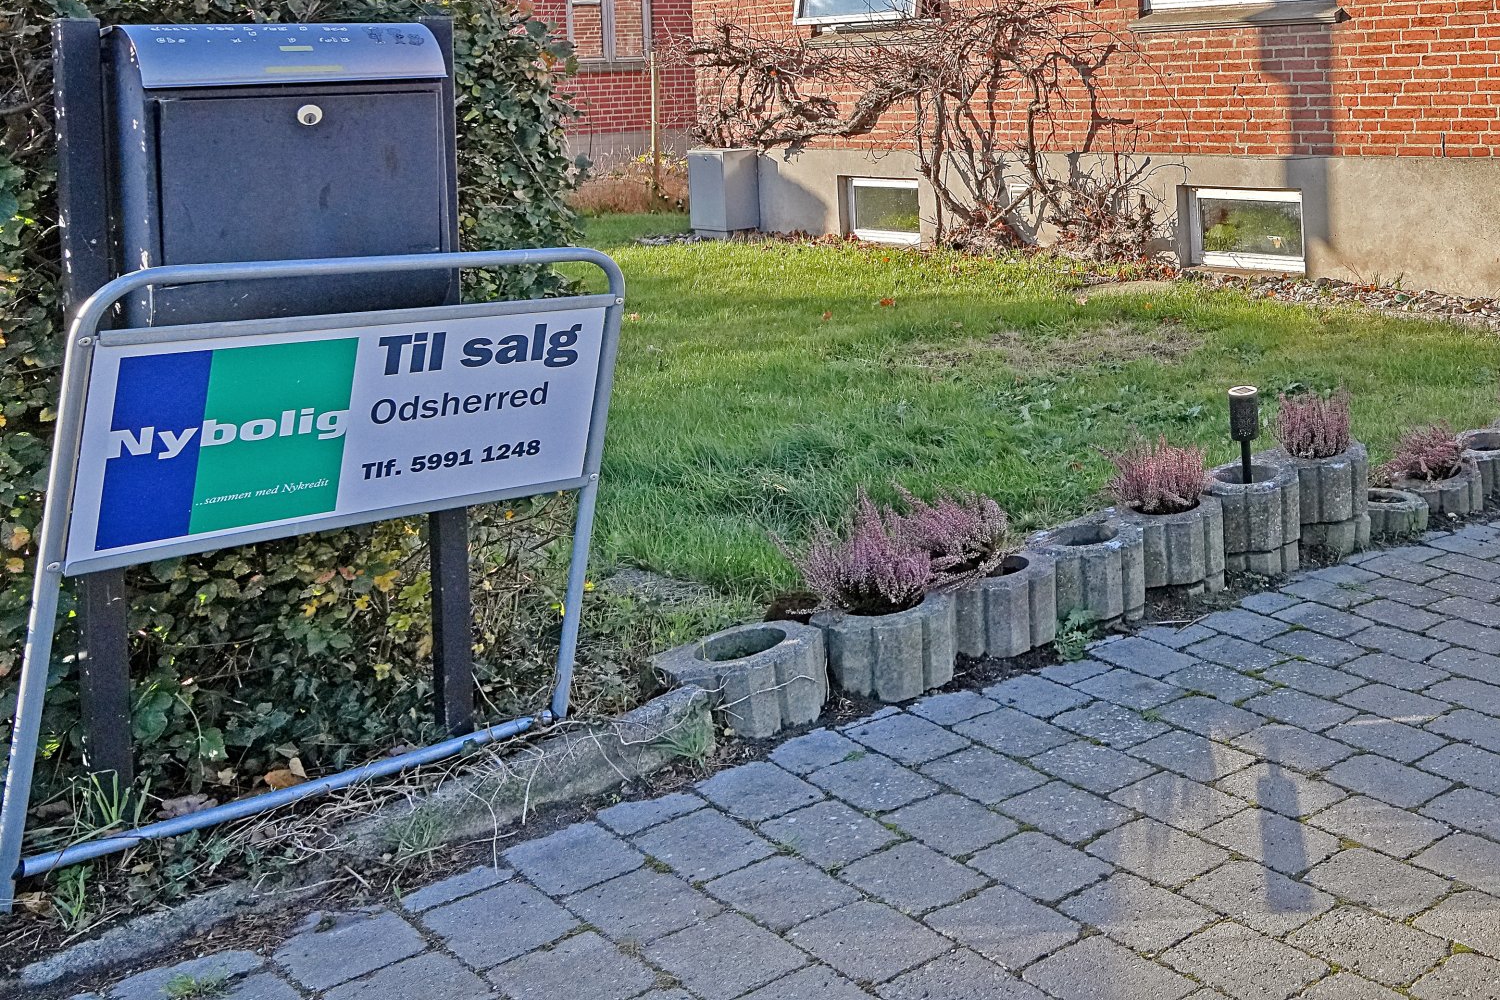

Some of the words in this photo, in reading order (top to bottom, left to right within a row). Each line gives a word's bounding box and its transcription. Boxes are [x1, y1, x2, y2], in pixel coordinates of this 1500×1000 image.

[378, 331, 447, 376] Til
[460, 323, 583, 368] salg
[370, 381, 549, 425] Odsherred
[105, 407, 351, 460] Nybolig
[361, 458, 402, 480] Tlf.
[410, 449, 473, 473] 5991
[480, 439, 541, 463] 1248
[254, 484, 280, 497] med
[281, 477, 330, 493] Nykredit
